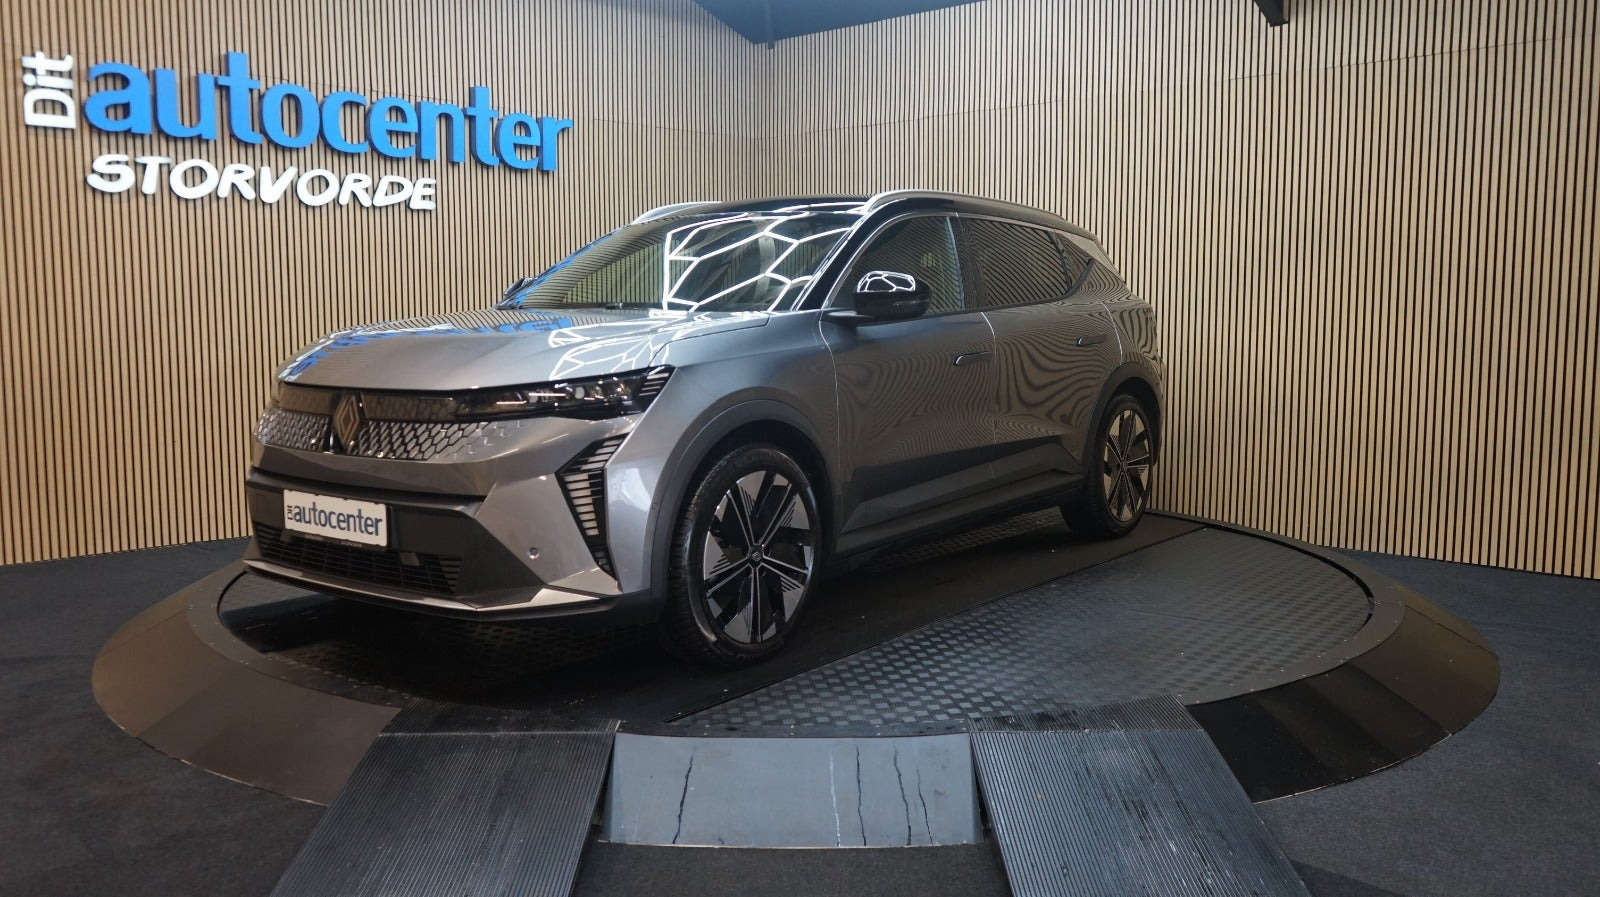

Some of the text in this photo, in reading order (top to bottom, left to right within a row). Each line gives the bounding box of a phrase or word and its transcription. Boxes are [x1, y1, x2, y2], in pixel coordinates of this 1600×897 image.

[22, 51, 573, 172] Dit autocenter
[86, 154, 437, 211] STORVORDE
[293, 501, 383, 536] autocenter
